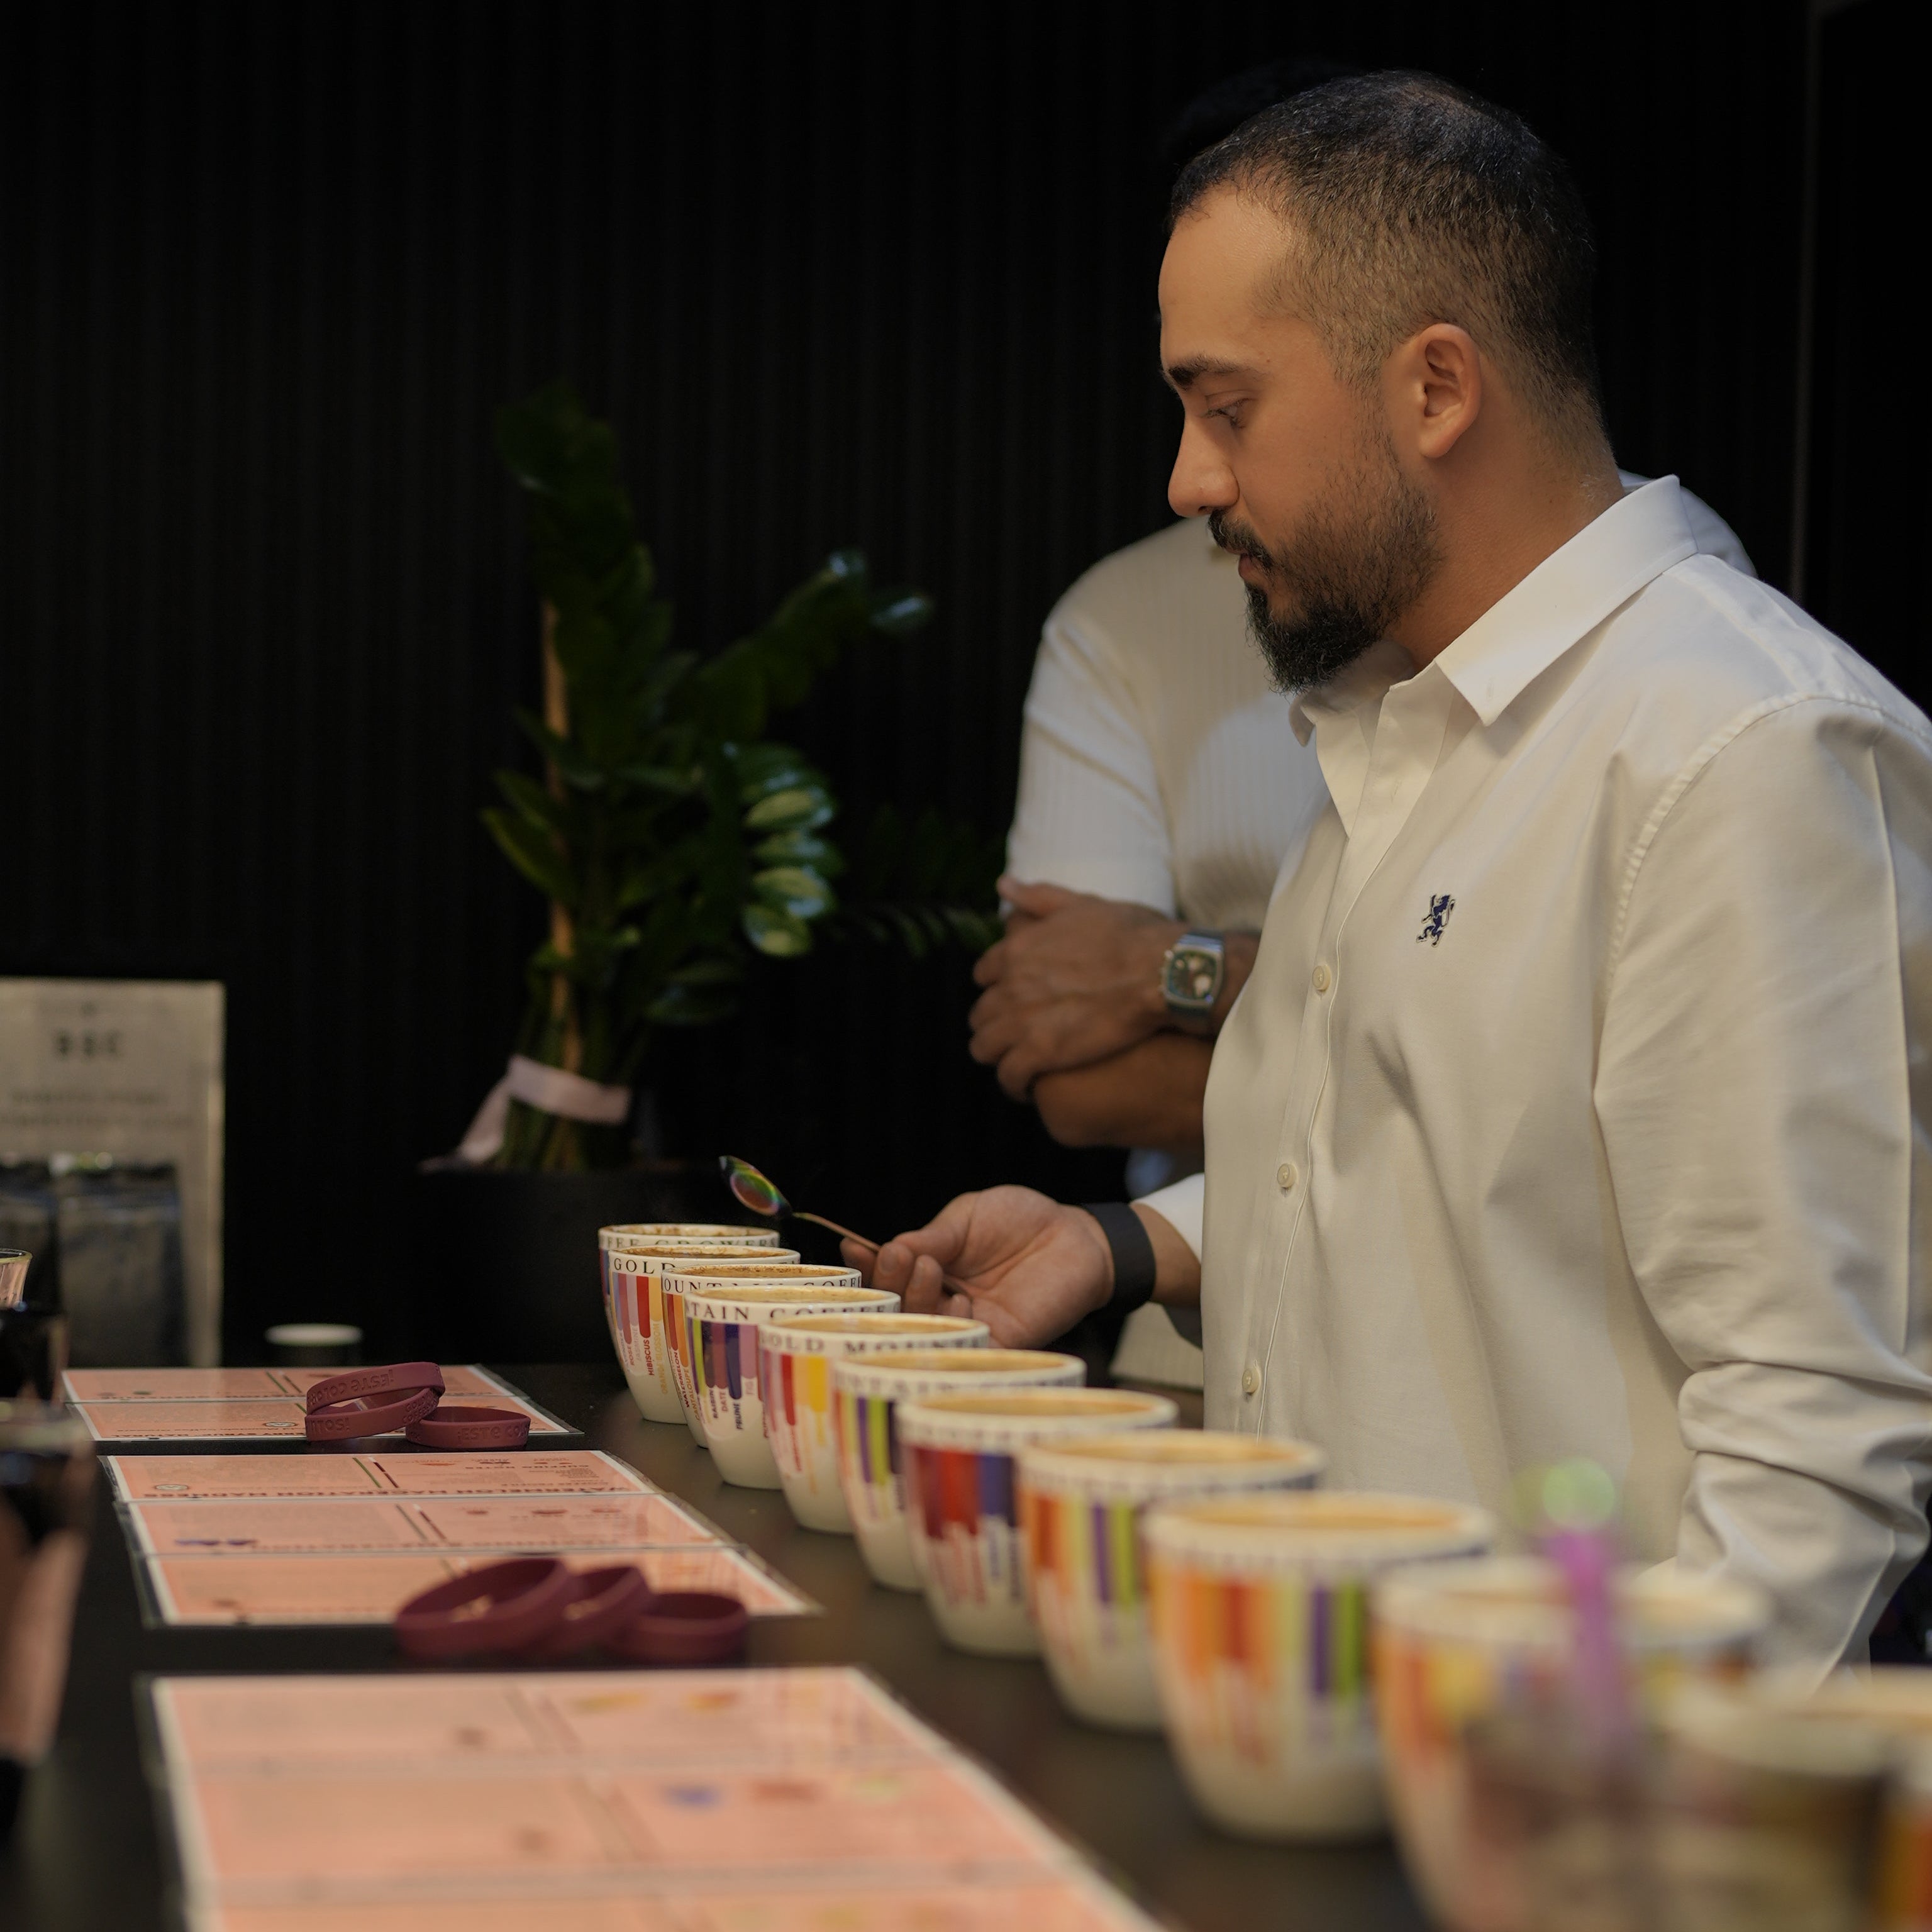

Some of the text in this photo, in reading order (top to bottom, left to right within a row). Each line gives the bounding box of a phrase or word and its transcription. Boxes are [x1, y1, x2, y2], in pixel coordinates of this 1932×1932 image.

[643, 1340, 654, 1376] HIBISCUS
[653, 1323, 663, 1361] BLOSSOM
[674, 1352, 689, 1408] WATERMELON
[683, 1368, 700, 1421] CANTALOUPE
[709, 1389, 719, 1419] RAISIN
[719, 1392, 728, 1412] DATE
[733, 1403, 744, 1430] PRUNE
